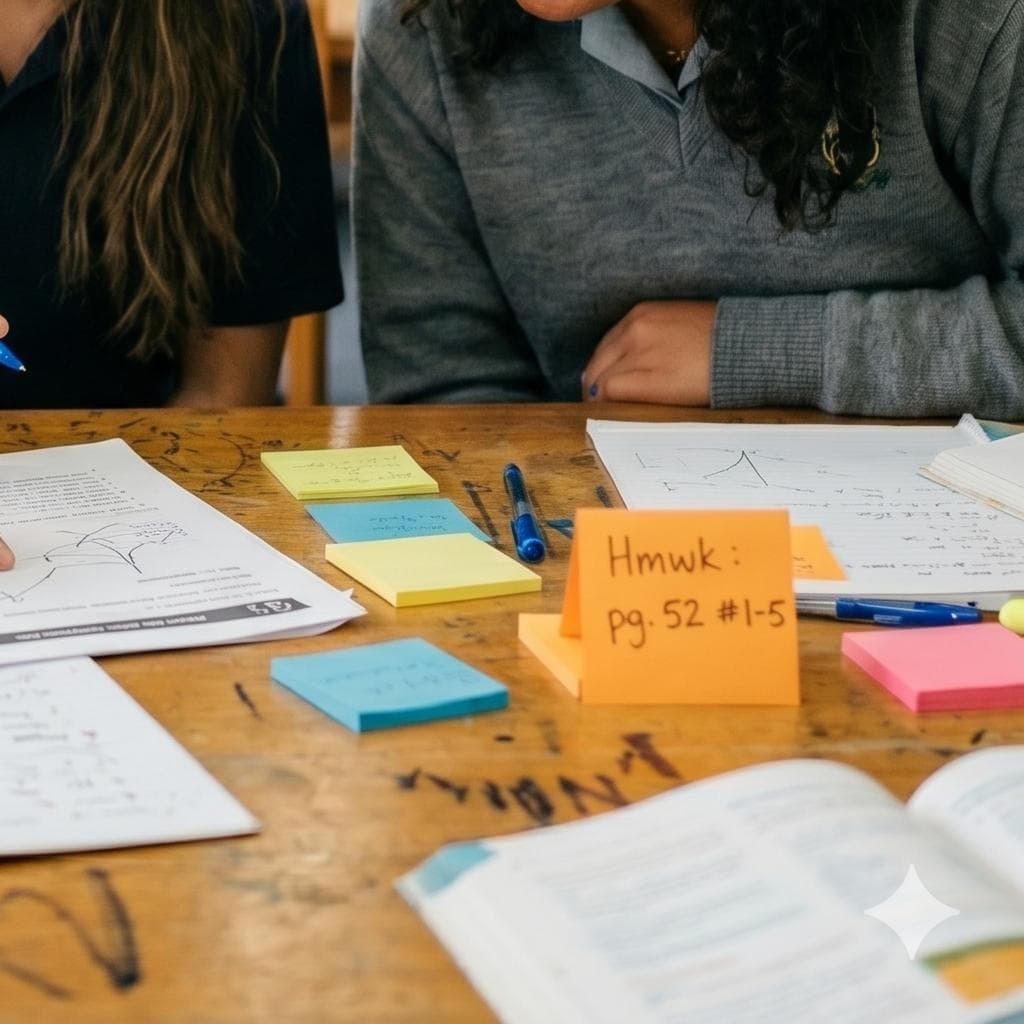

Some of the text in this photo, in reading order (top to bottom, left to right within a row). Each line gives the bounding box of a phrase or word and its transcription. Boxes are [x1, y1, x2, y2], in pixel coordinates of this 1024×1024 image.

[607, 597, 787, 649] pg. 52 #1-5
